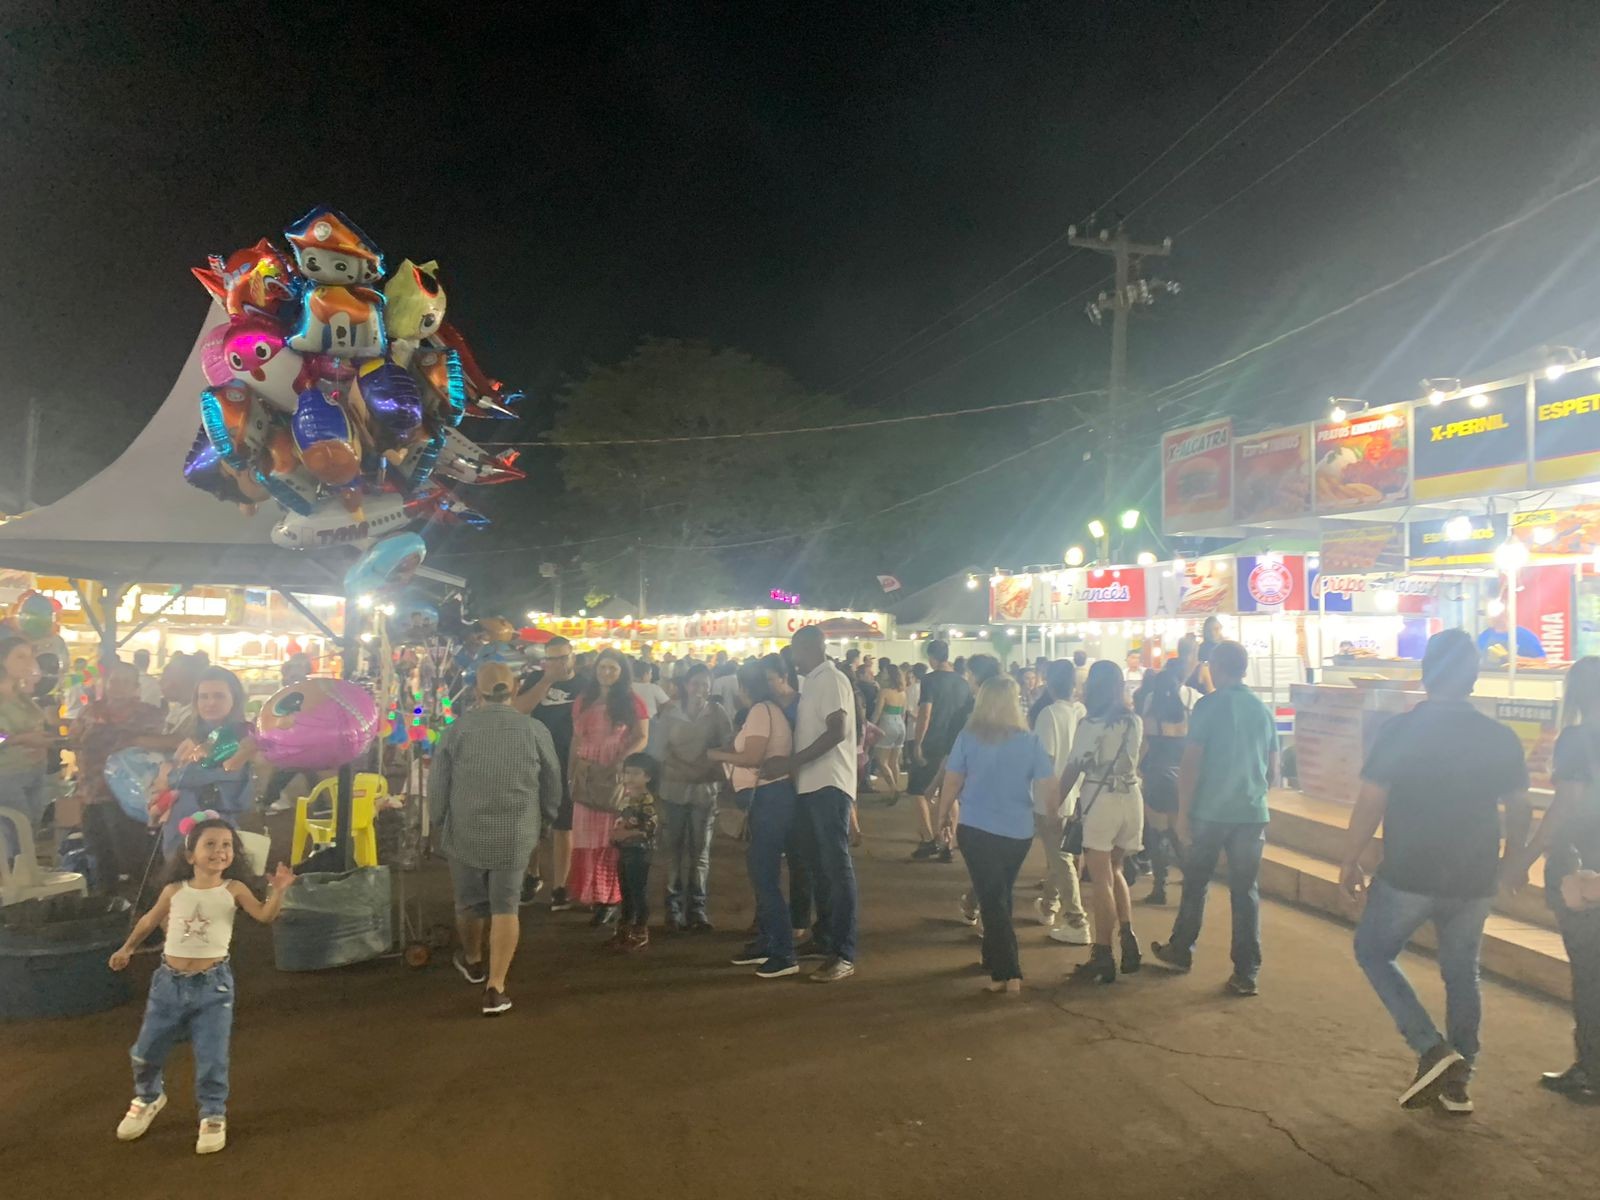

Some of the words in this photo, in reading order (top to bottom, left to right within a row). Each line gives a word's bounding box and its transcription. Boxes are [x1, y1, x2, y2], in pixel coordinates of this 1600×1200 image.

[1538, 393, 1600, 421] ESPET
[1430, 413, 1509, 442] X-PERNIL
[1167, 427, 1229, 463] X-ALCATRA
